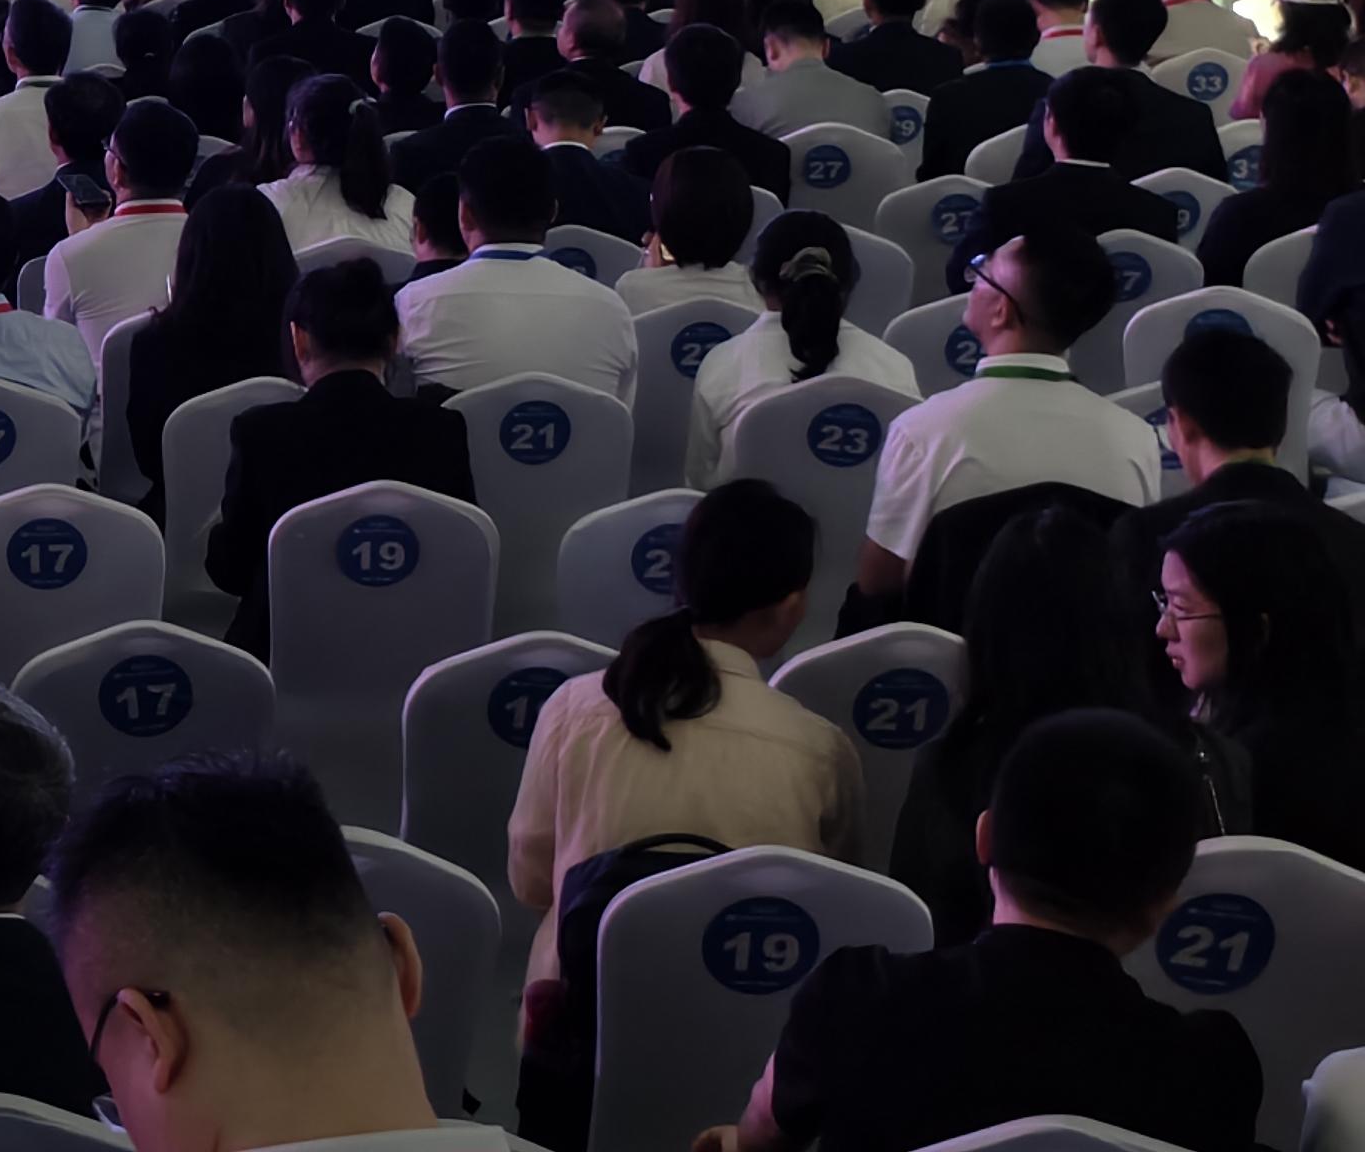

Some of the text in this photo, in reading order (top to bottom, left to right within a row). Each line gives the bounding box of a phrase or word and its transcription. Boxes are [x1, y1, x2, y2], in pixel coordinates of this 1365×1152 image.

[1193, 75, 1222, 93] 33
[809, 161, 844, 180] 27
[510, 423, 556, 450] 21
[816, 425, 869, 454] 23
[19, 543, 76, 575] 17
[352, 540, 406, 572] 19
[115, 682, 178, 721] 17
[869, 696, 933, 732] 21
[722, 931, 801, 973] 19
[1169, 925, 1251, 972] 21
